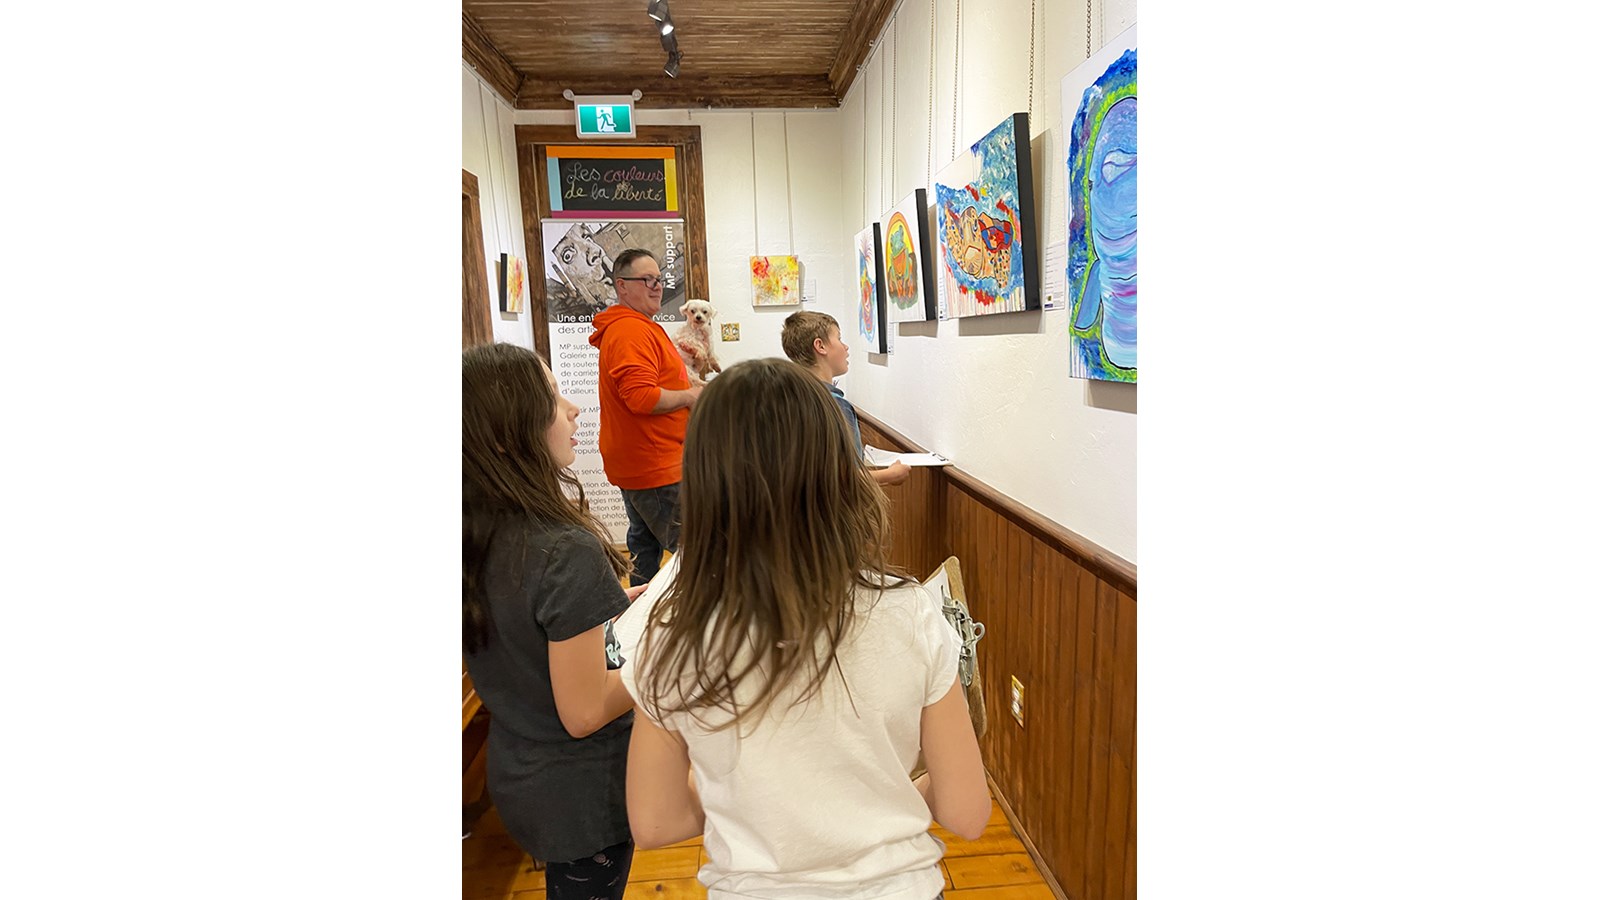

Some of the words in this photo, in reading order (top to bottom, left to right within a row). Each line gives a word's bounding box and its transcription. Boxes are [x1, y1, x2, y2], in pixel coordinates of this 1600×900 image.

[567, 162, 600, 183] Les
[604, 166, 664, 183] couleurs
[564, 180, 588, 199] de
[591, 183, 610, 200] la
[611, 184, 663, 201] liberté
[663, 225, 676, 269] suppart
[666, 272, 676, 290] MP
[557, 313, 577, 323] Une
[578, 313, 595, 323] ent
[652, 312, 676, 322] rvice
[557, 325, 576, 335] des
[560, 351, 587, 360] Galerie
[571, 379, 599, 387] profess
[581, 467, 605, 475] servic
[602, 512, 628, 520] photog
